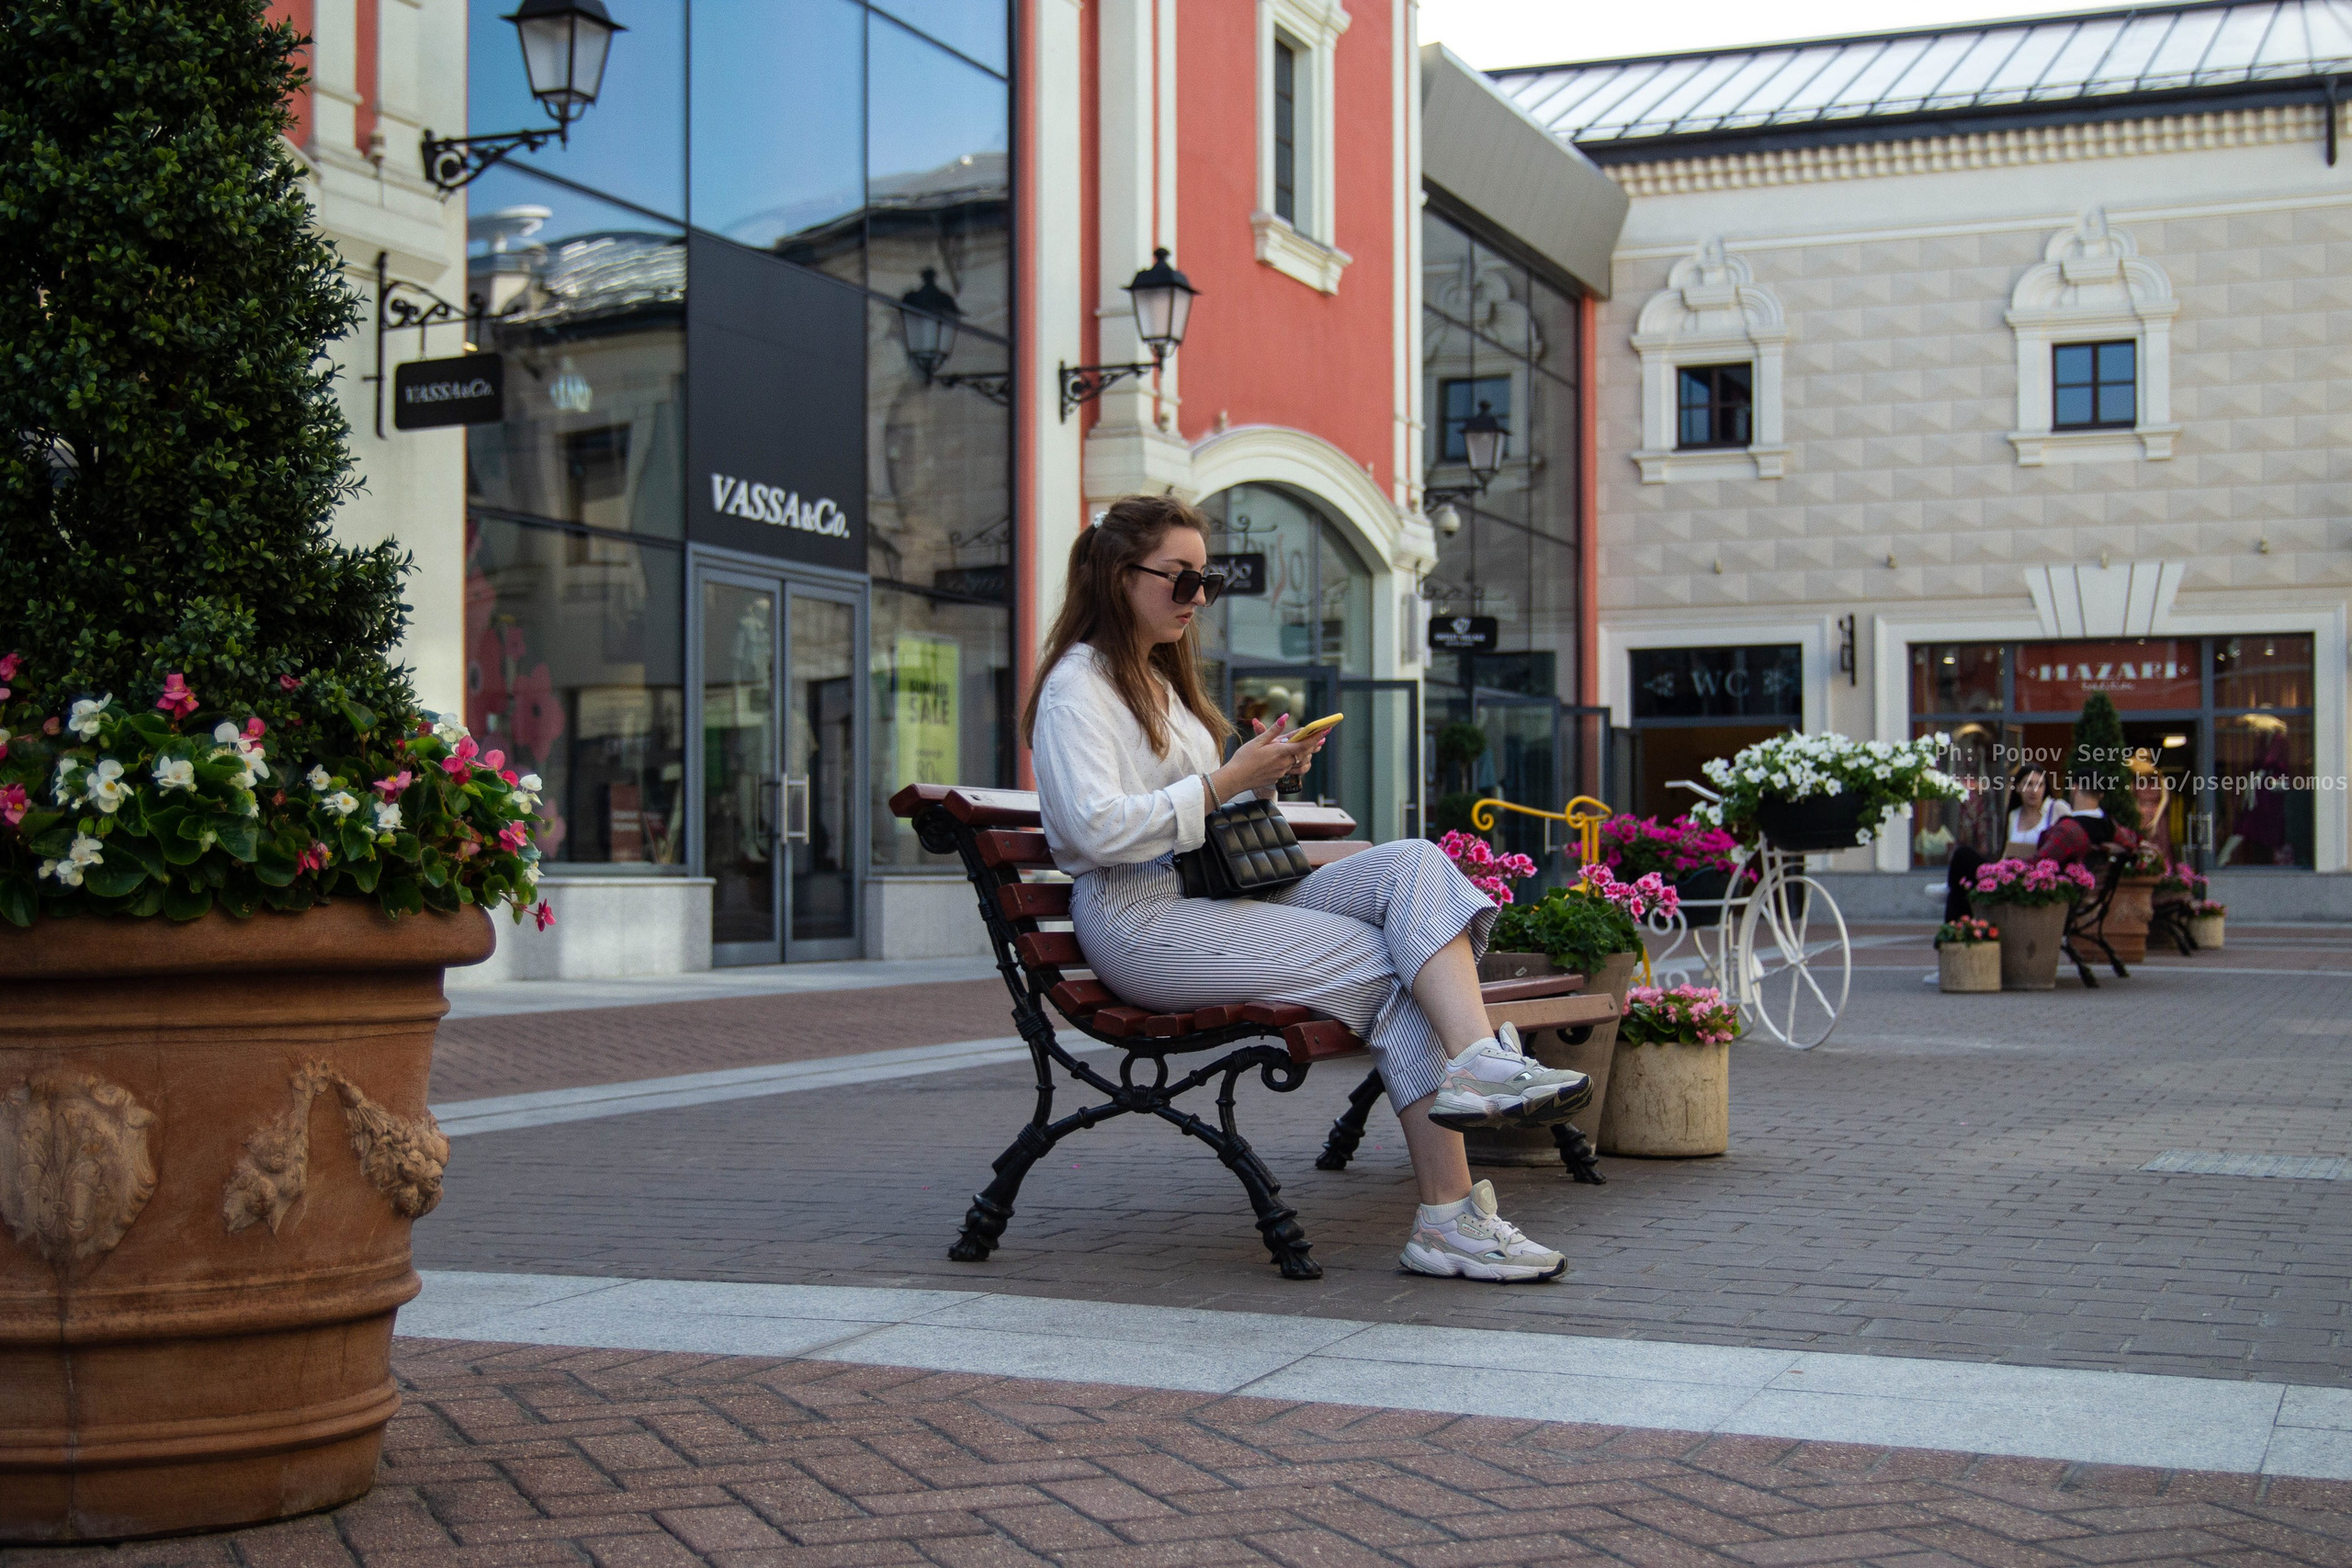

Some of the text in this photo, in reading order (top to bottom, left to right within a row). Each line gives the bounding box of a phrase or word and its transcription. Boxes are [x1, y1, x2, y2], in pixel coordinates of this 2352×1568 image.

[711, 472, 851, 539] VASSA&Co.
[1690, 669, 1749, 697] WC
[2039, 661, 2177, 682] MAZARI
[908, 696, 950, 726] SALE
